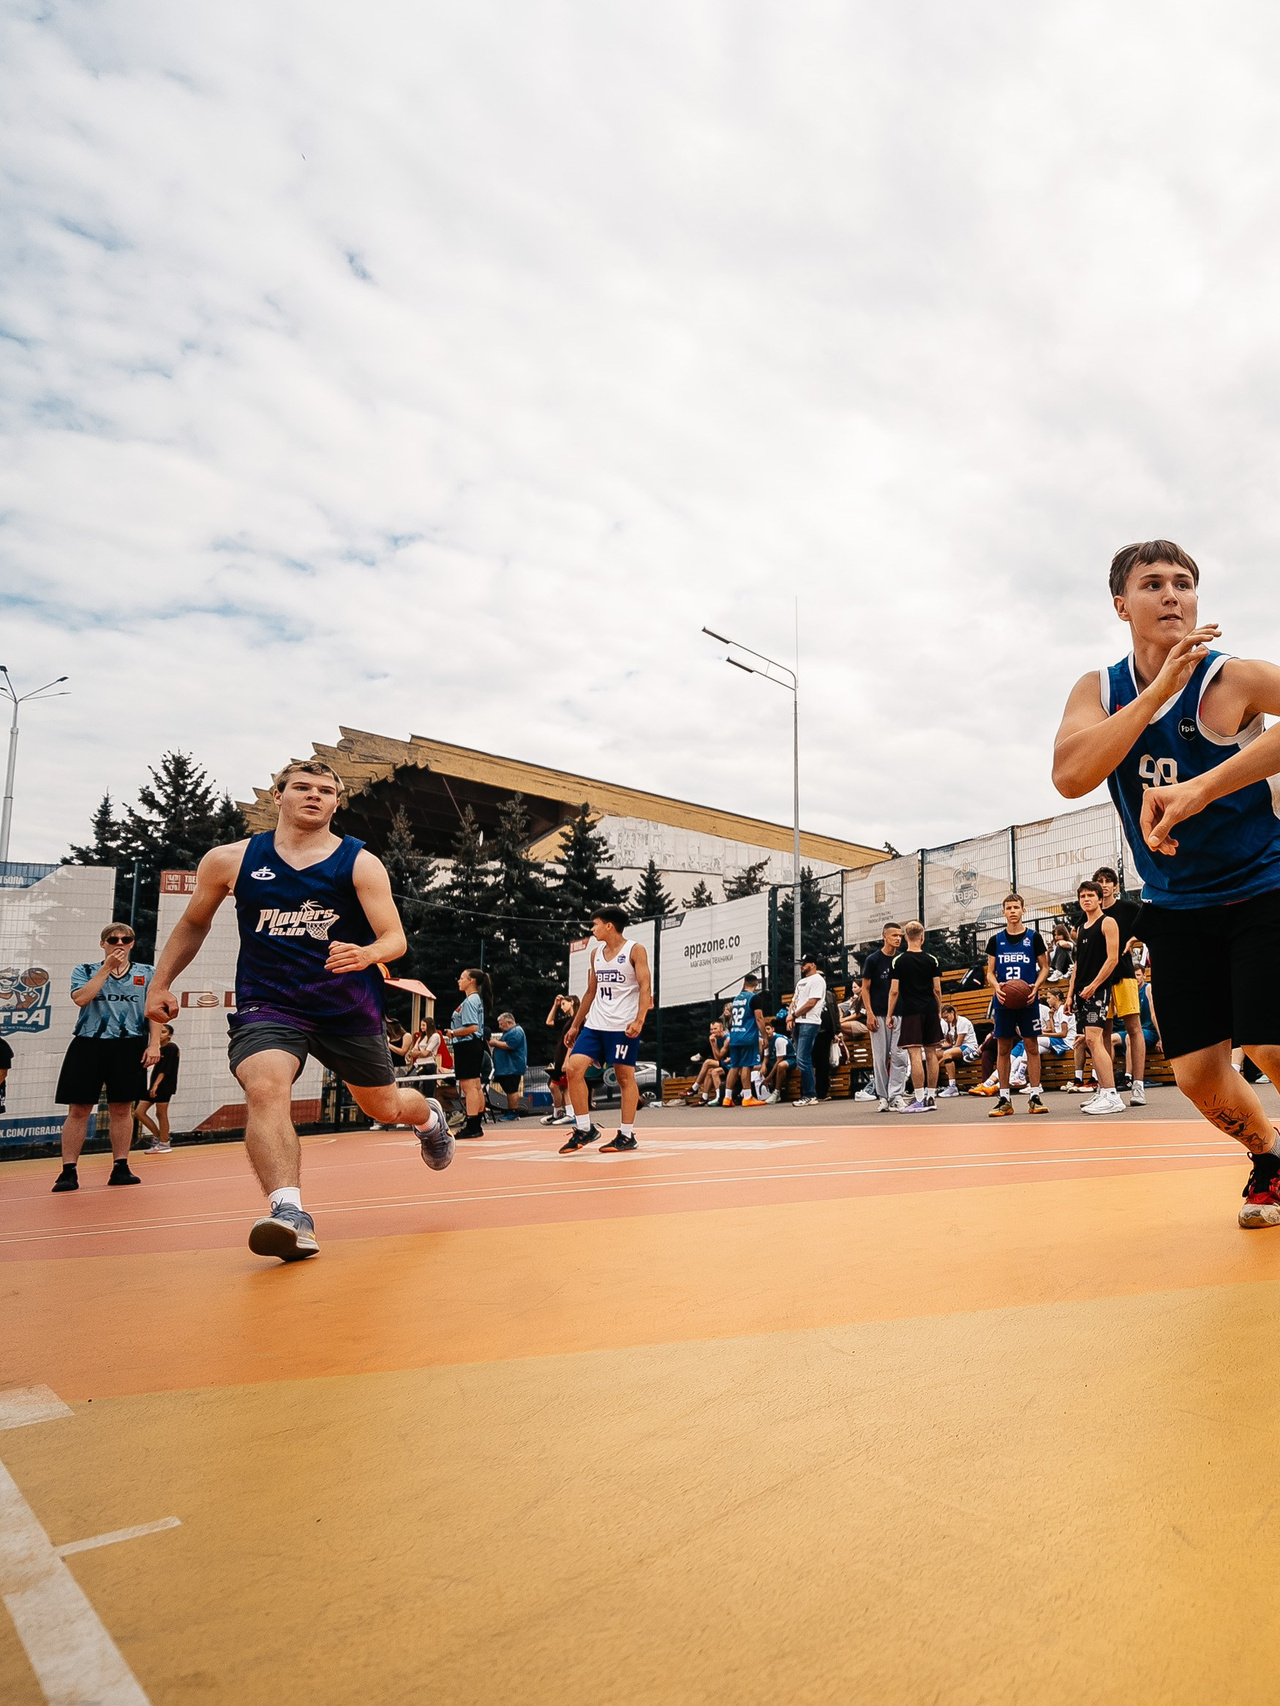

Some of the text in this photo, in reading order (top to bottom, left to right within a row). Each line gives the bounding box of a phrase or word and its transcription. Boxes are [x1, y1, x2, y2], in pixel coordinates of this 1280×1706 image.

[255, 908, 335, 933] Players
[268, 927, 306, 936] CLUB
[684, 934, 741, 960] appzone.co
[998, 954, 1030, 964] ТВЕРЬ
[595, 972, 625, 982] ВЕРЬ
[1006, 967, 1021, 980] 23
[600, 986, 612, 1000] 14
[615, 1044, 629, 1060] 14
